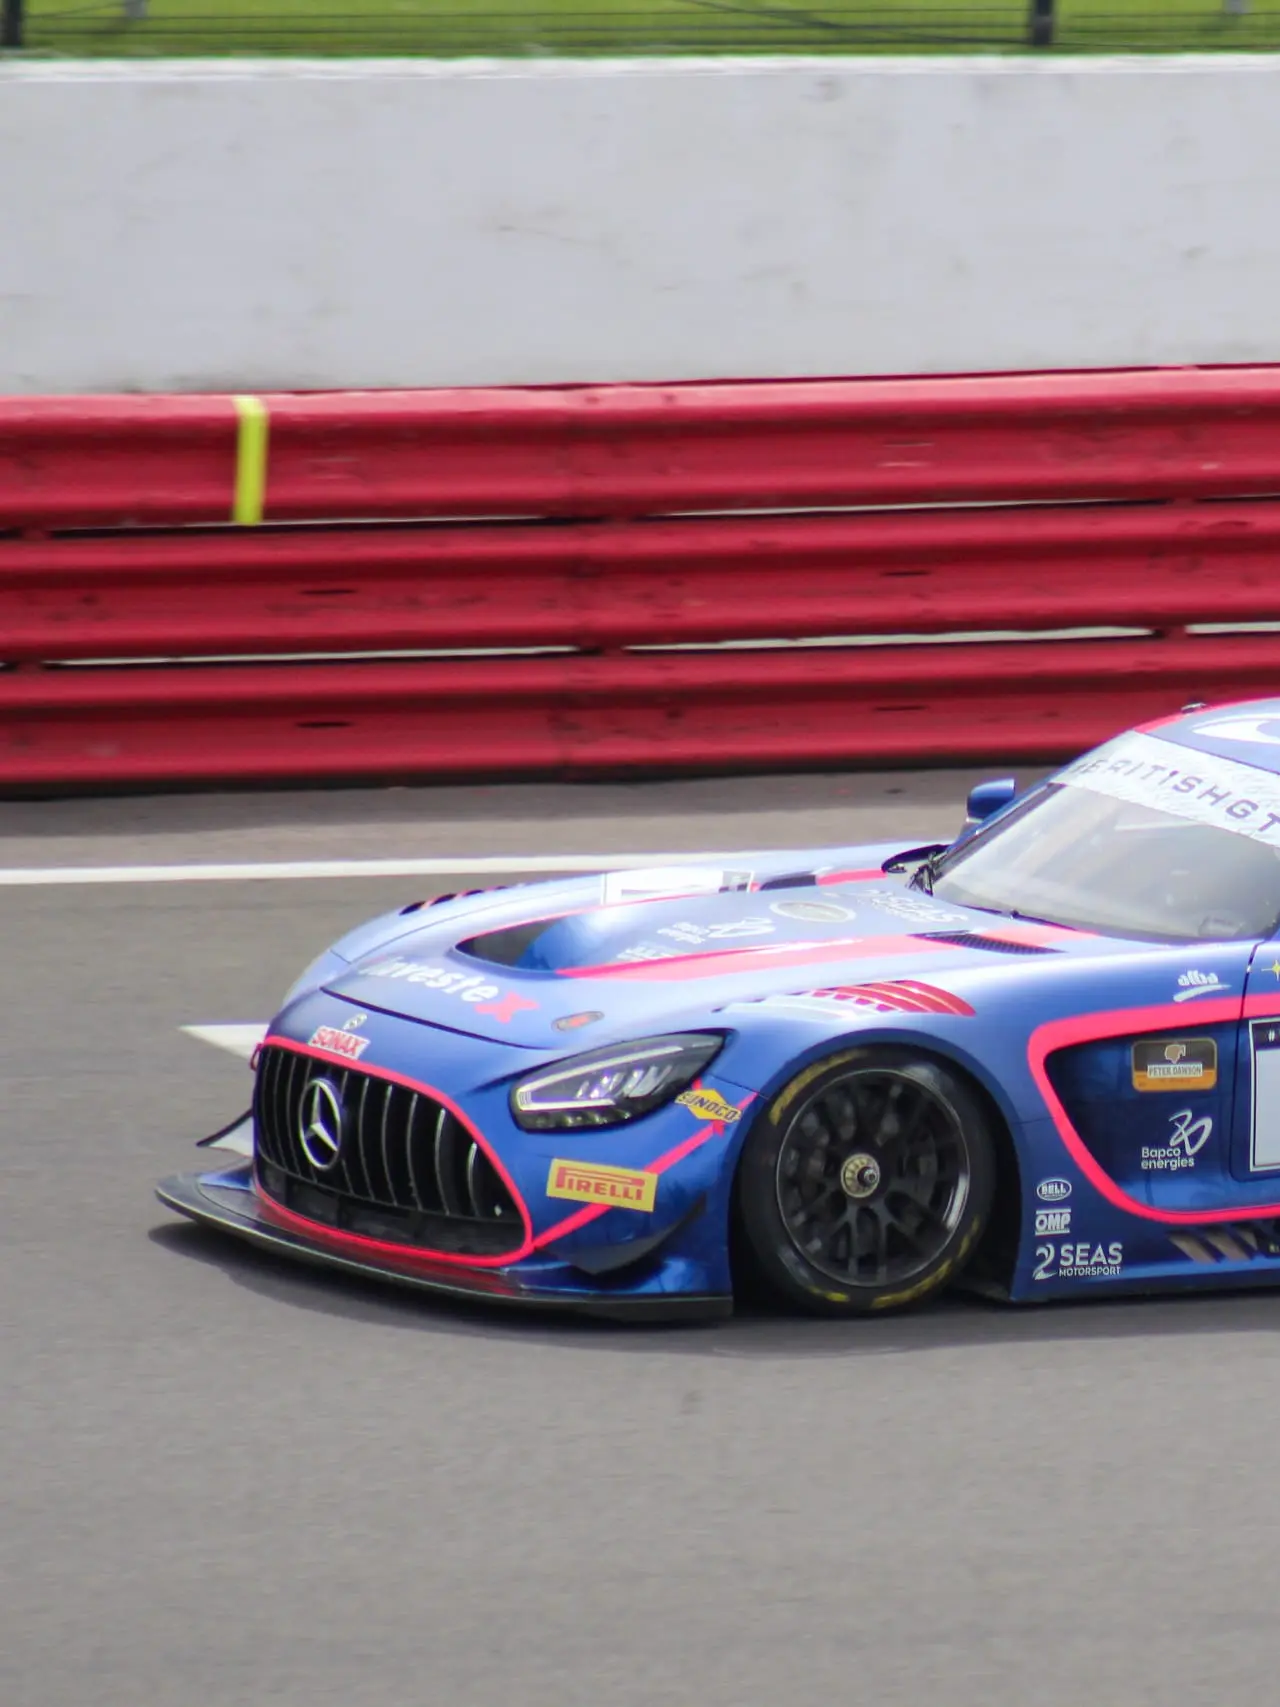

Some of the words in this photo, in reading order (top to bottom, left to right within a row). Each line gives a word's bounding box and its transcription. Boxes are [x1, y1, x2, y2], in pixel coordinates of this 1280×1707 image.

[311, 1028, 366, 1057] SONAX
[677, 1091, 742, 1124] SUNOCO
[1141, 1146, 1181, 1160] Bapco
[1141, 1157, 1195, 1171] energies
[556, 1165, 645, 1201] PIRELLI
[1035, 1212, 1071, 1232] OMP
[1032, 1243, 1058, 1280] 2
[1060, 1242, 1123, 1267] SEAS
[1059, 1265, 1121, 1277] MOTORSPORT
